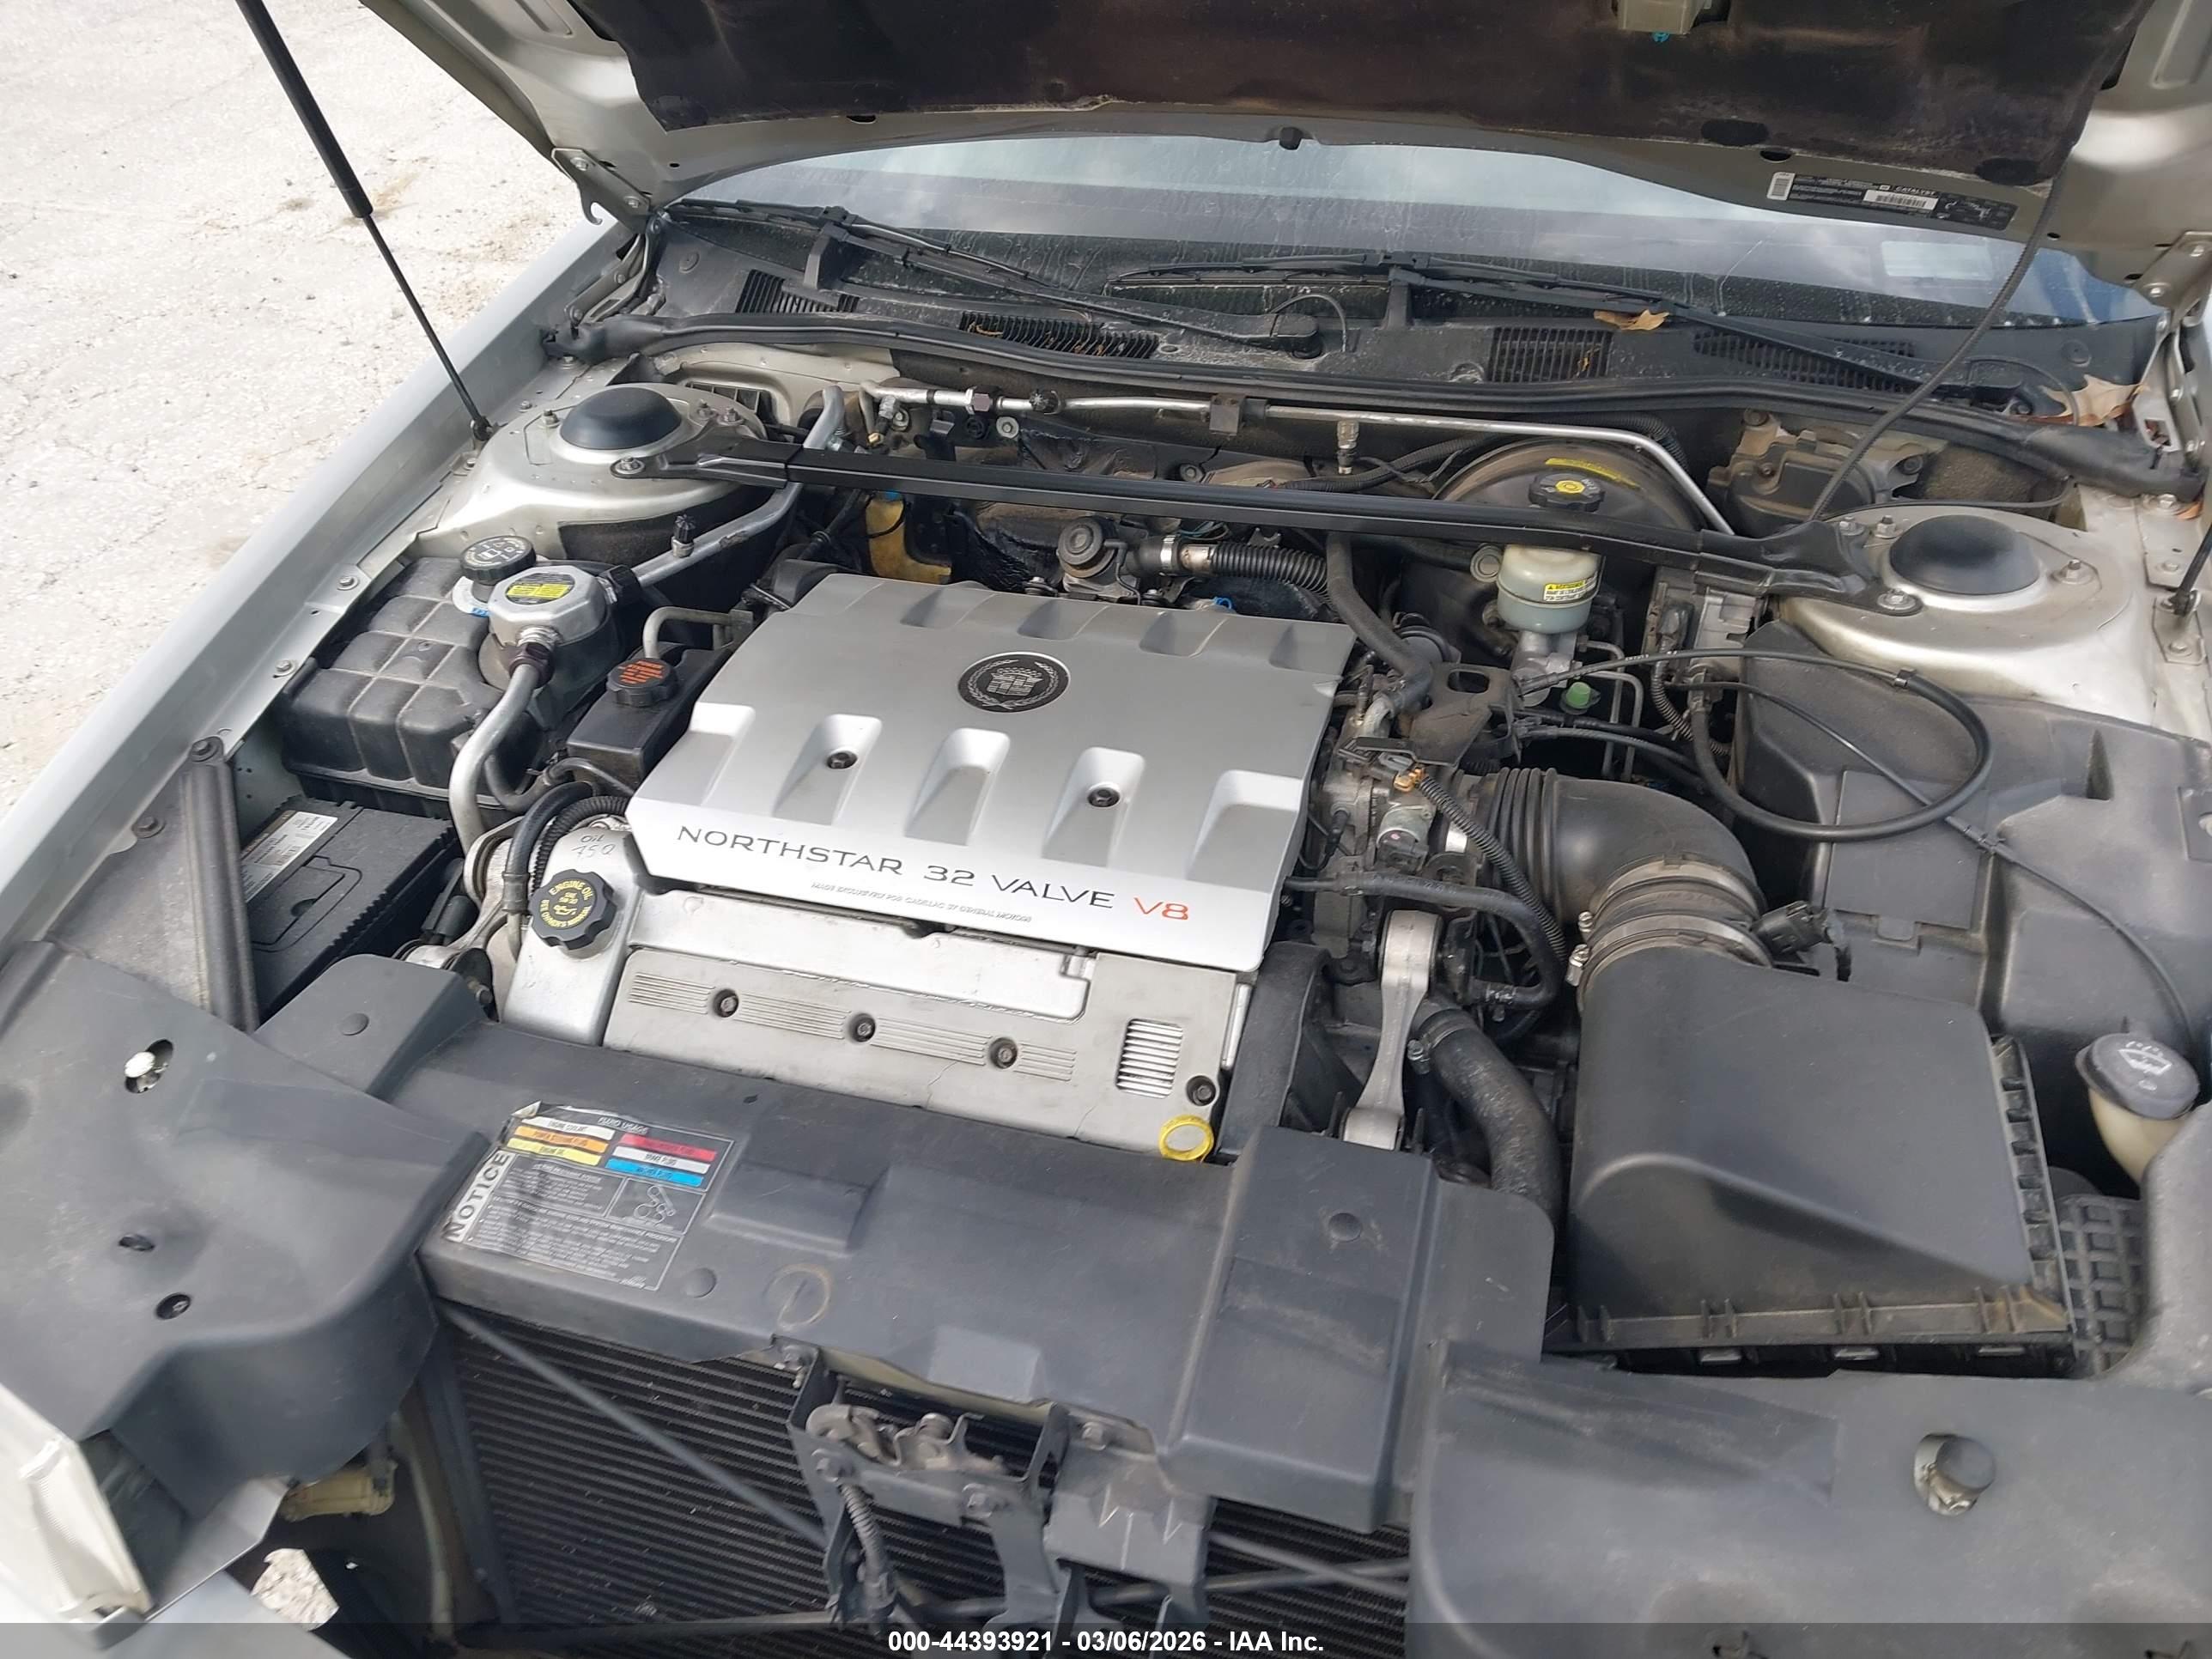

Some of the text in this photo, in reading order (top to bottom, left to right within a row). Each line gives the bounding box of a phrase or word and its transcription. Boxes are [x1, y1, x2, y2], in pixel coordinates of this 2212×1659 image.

[549, 880, 586, 896] ENGINE
[581, 886, 594, 901] OIL
[678, 825, 1188, 921] NORTHSTAR 32 VALVE V8
[441, 1152, 511, 1238] NOTICE
